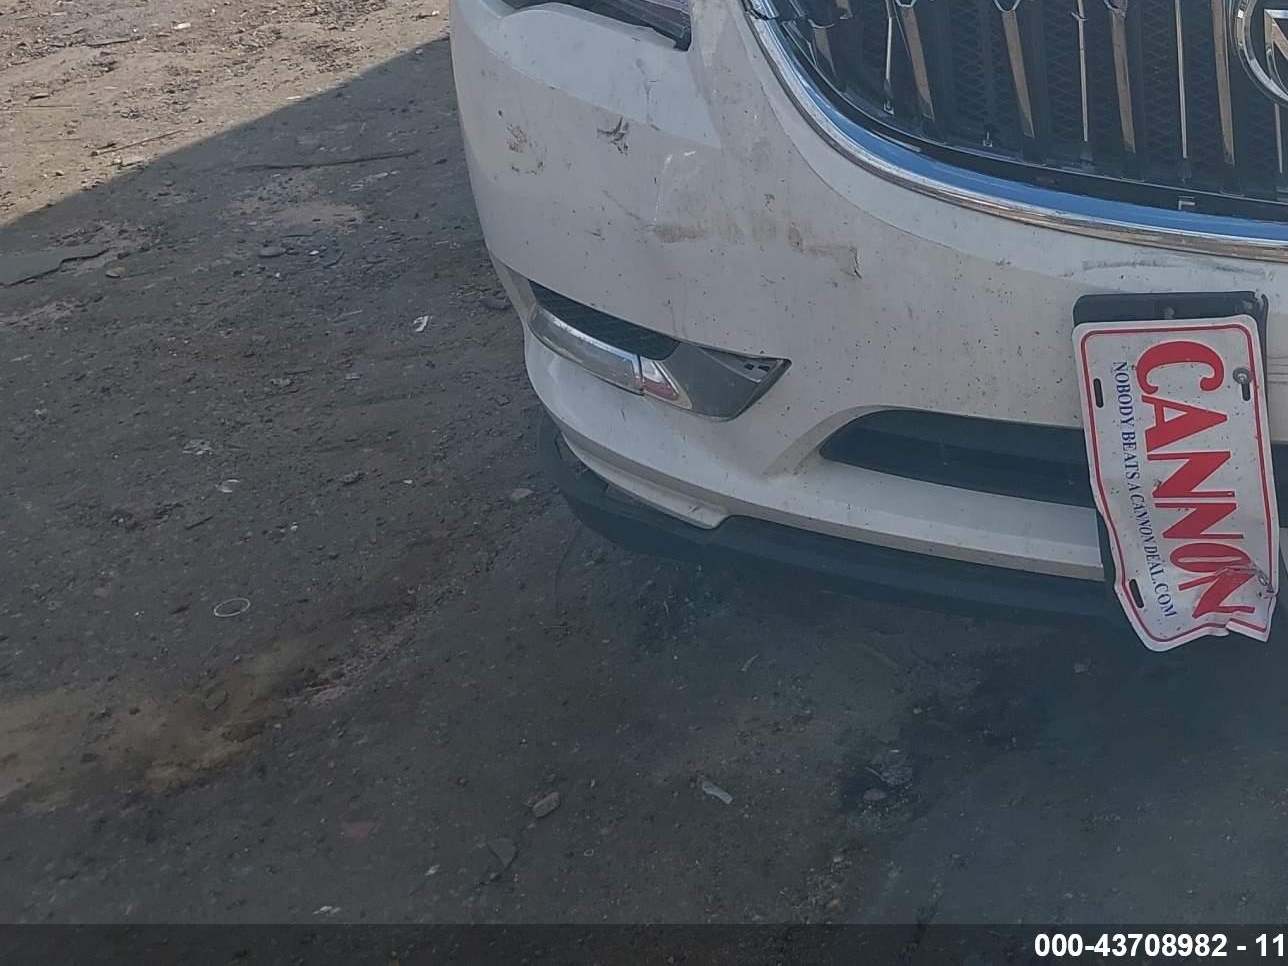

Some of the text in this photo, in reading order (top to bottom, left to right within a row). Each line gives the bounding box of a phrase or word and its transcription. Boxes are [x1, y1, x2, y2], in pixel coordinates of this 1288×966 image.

[1112, 361, 1178, 618] NOBODY BEATS A CANNON DEAL.COM
[1135, 340, 1256, 620] CANNON
